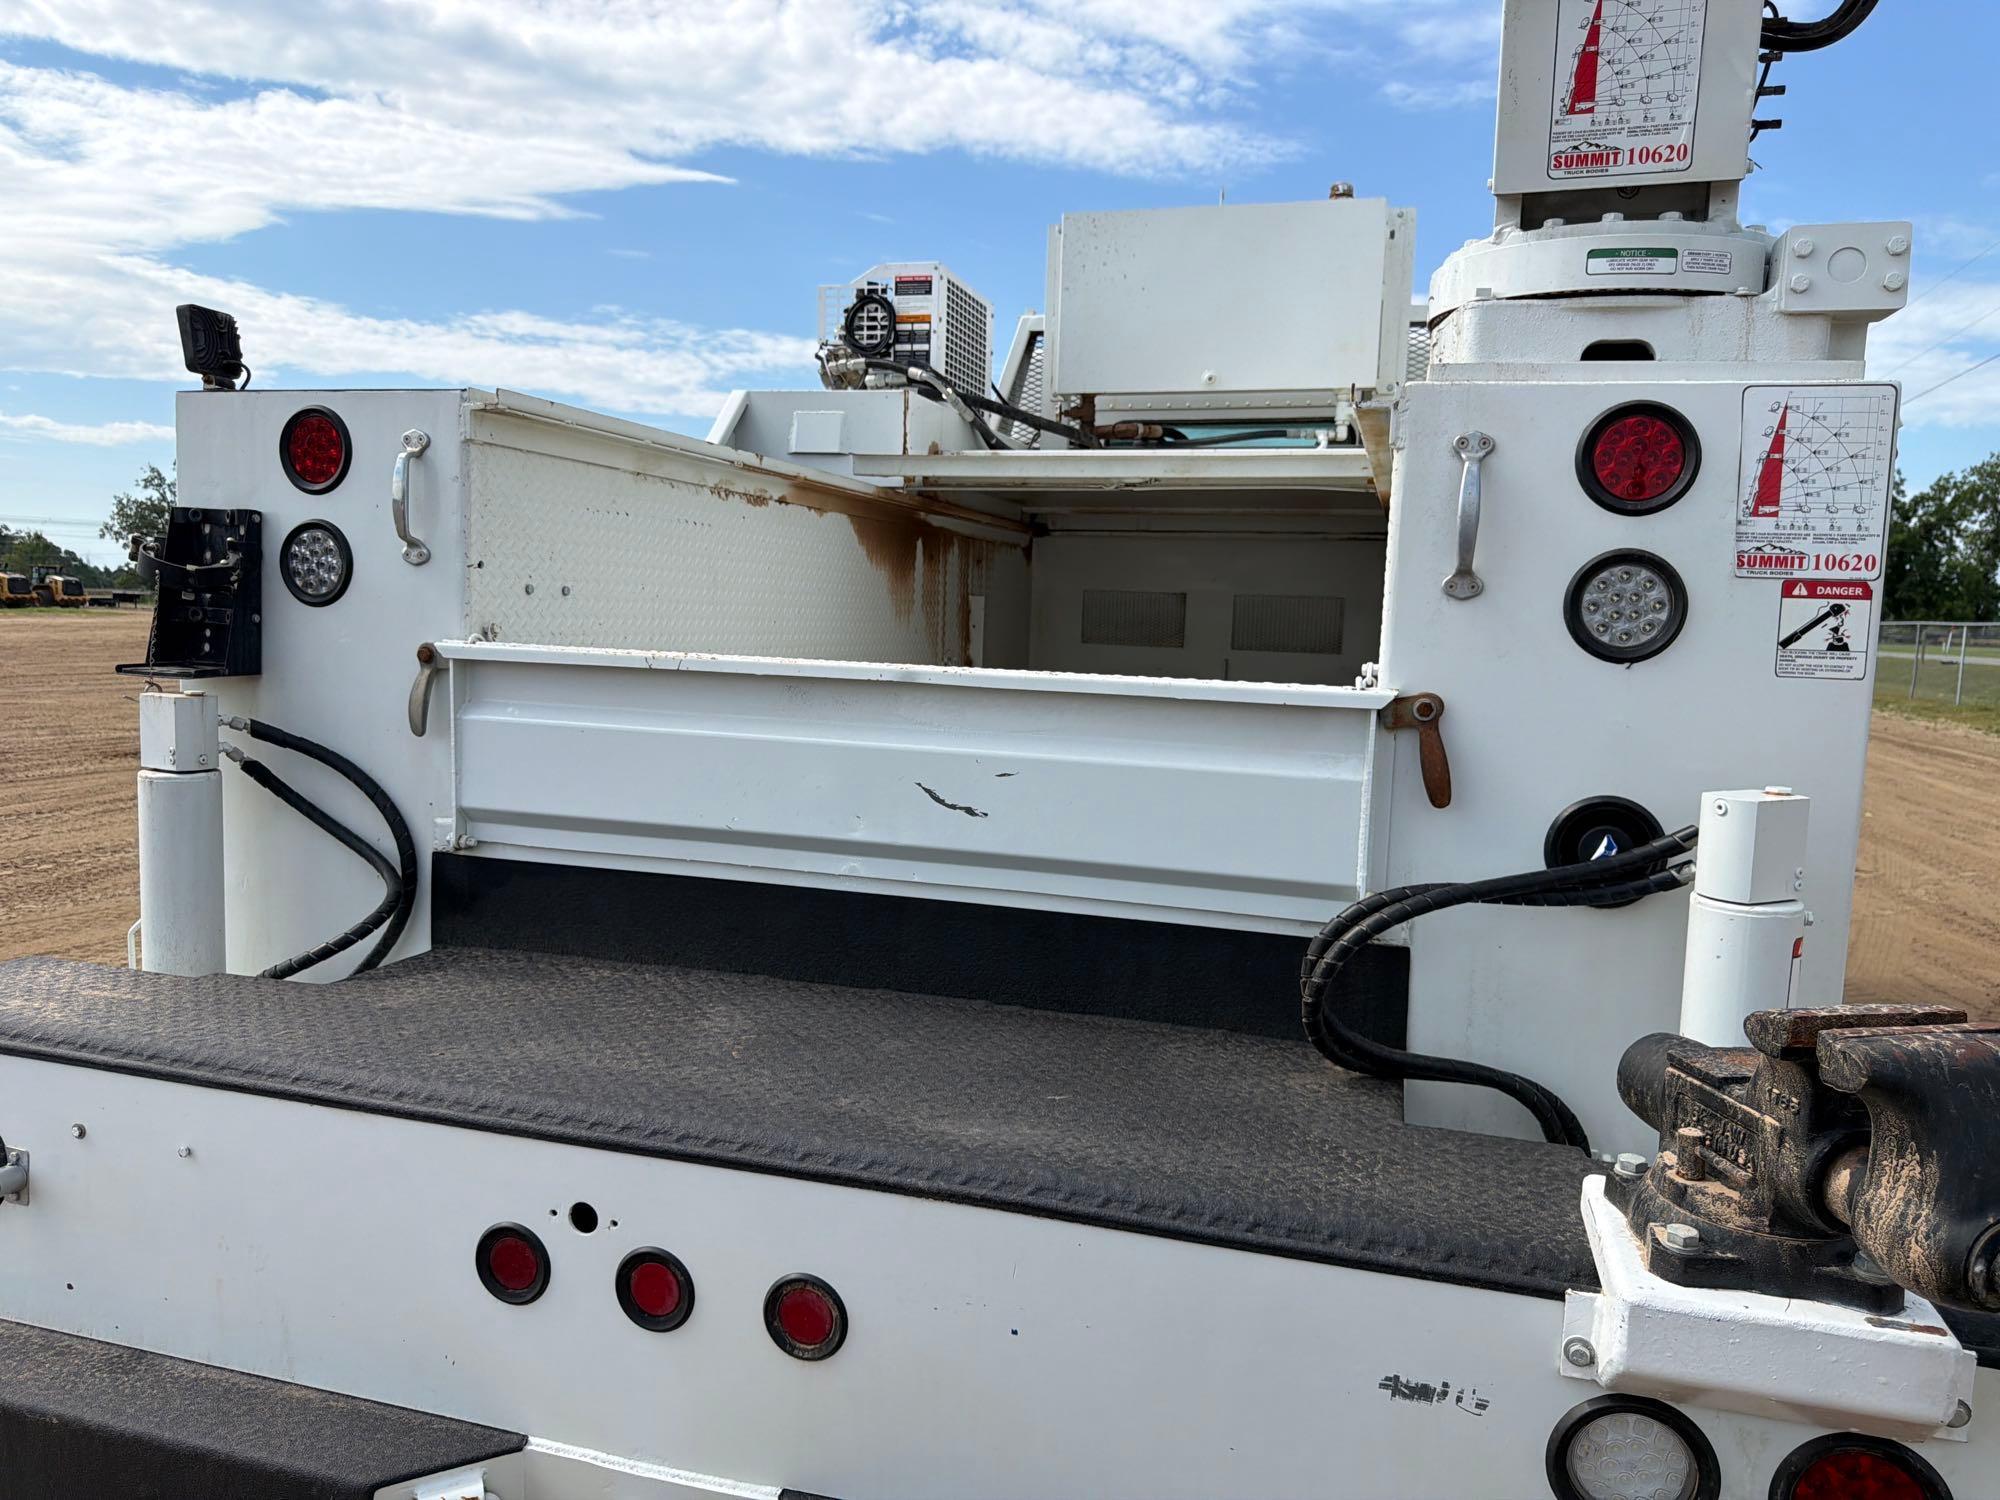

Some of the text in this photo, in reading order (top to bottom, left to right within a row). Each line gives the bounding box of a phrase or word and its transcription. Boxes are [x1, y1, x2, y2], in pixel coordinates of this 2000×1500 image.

[1552, 143, 1688, 169] SUMMIT 10620
[1620, 249, 1647, 257] NOTICE
[1736, 553, 1877, 572] SUMMIT 10620
[1816, 586, 1863, 596] DANGER
